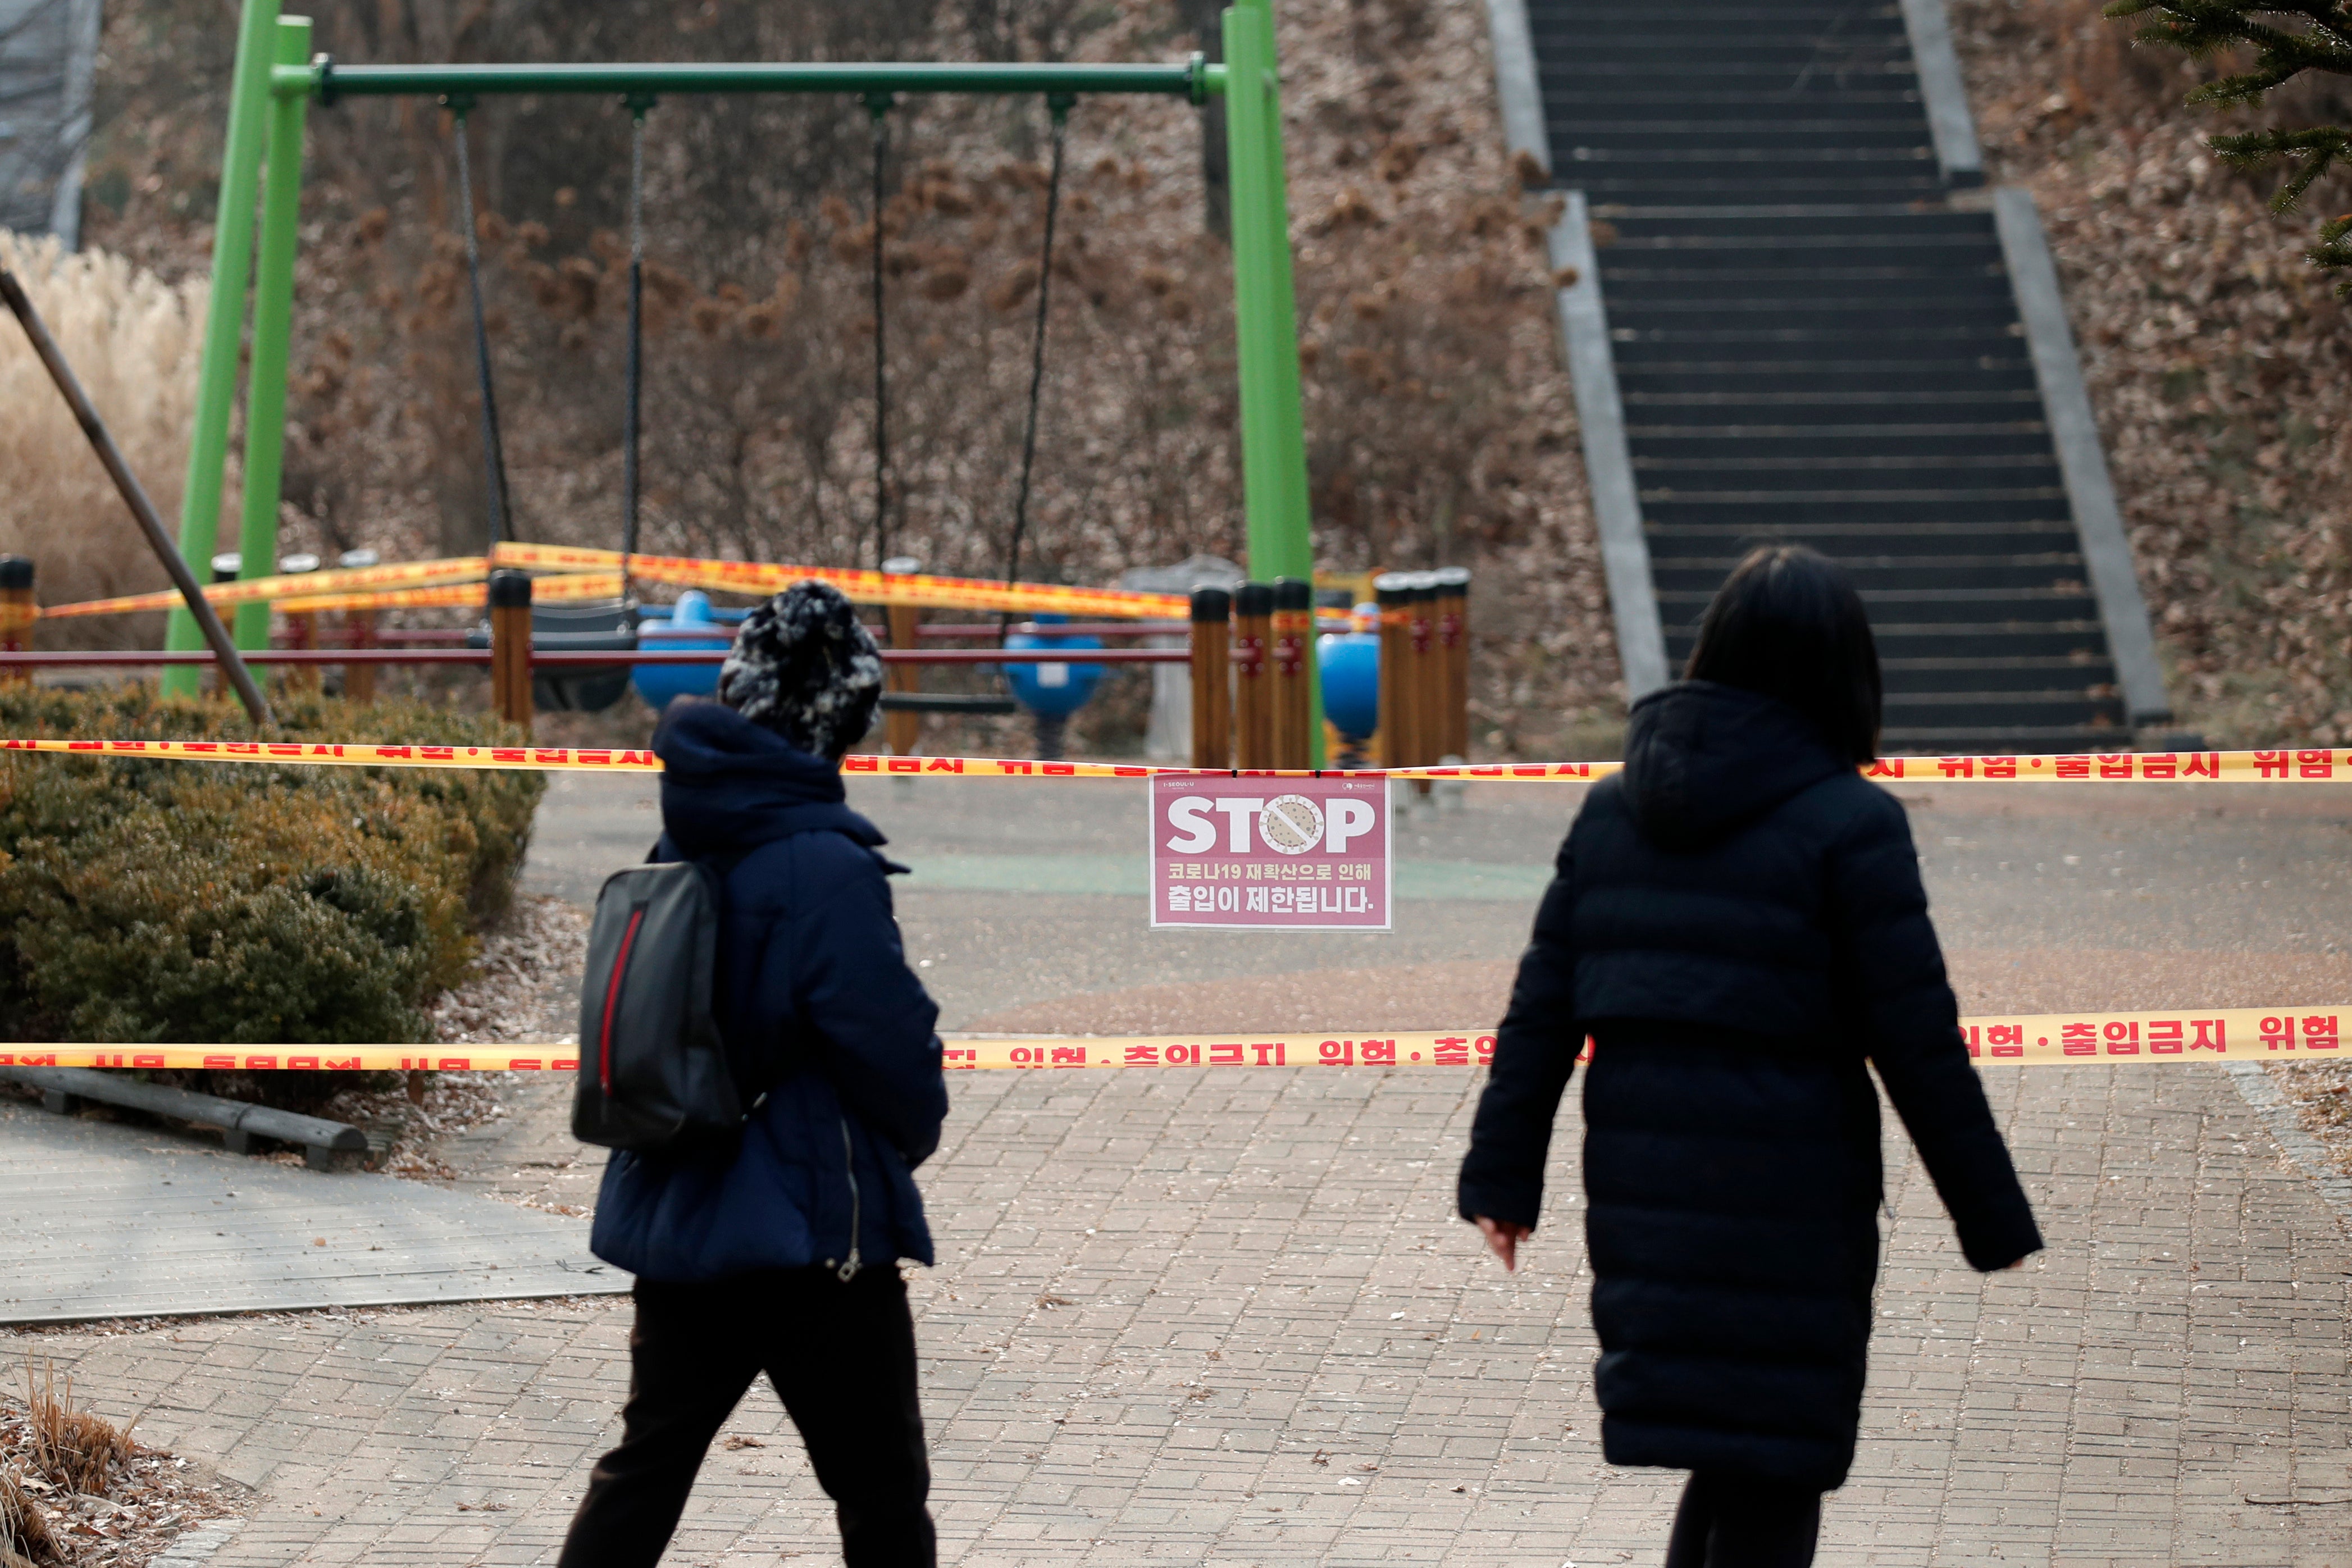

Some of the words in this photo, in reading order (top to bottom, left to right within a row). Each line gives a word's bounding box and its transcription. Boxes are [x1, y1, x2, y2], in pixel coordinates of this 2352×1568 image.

[1166, 794, 1375, 855] STOP
[1168, 863, 1241, 880] 코로나19
[1246, 863, 1332, 881] 재확산으로
[1338, 863, 1371, 881] 인해
[1168, 885, 1239, 913] 출입이
[1246, 886, 1374, 914] 제한됩니다.
[2259, 1015, 2339, 1050] 위험
